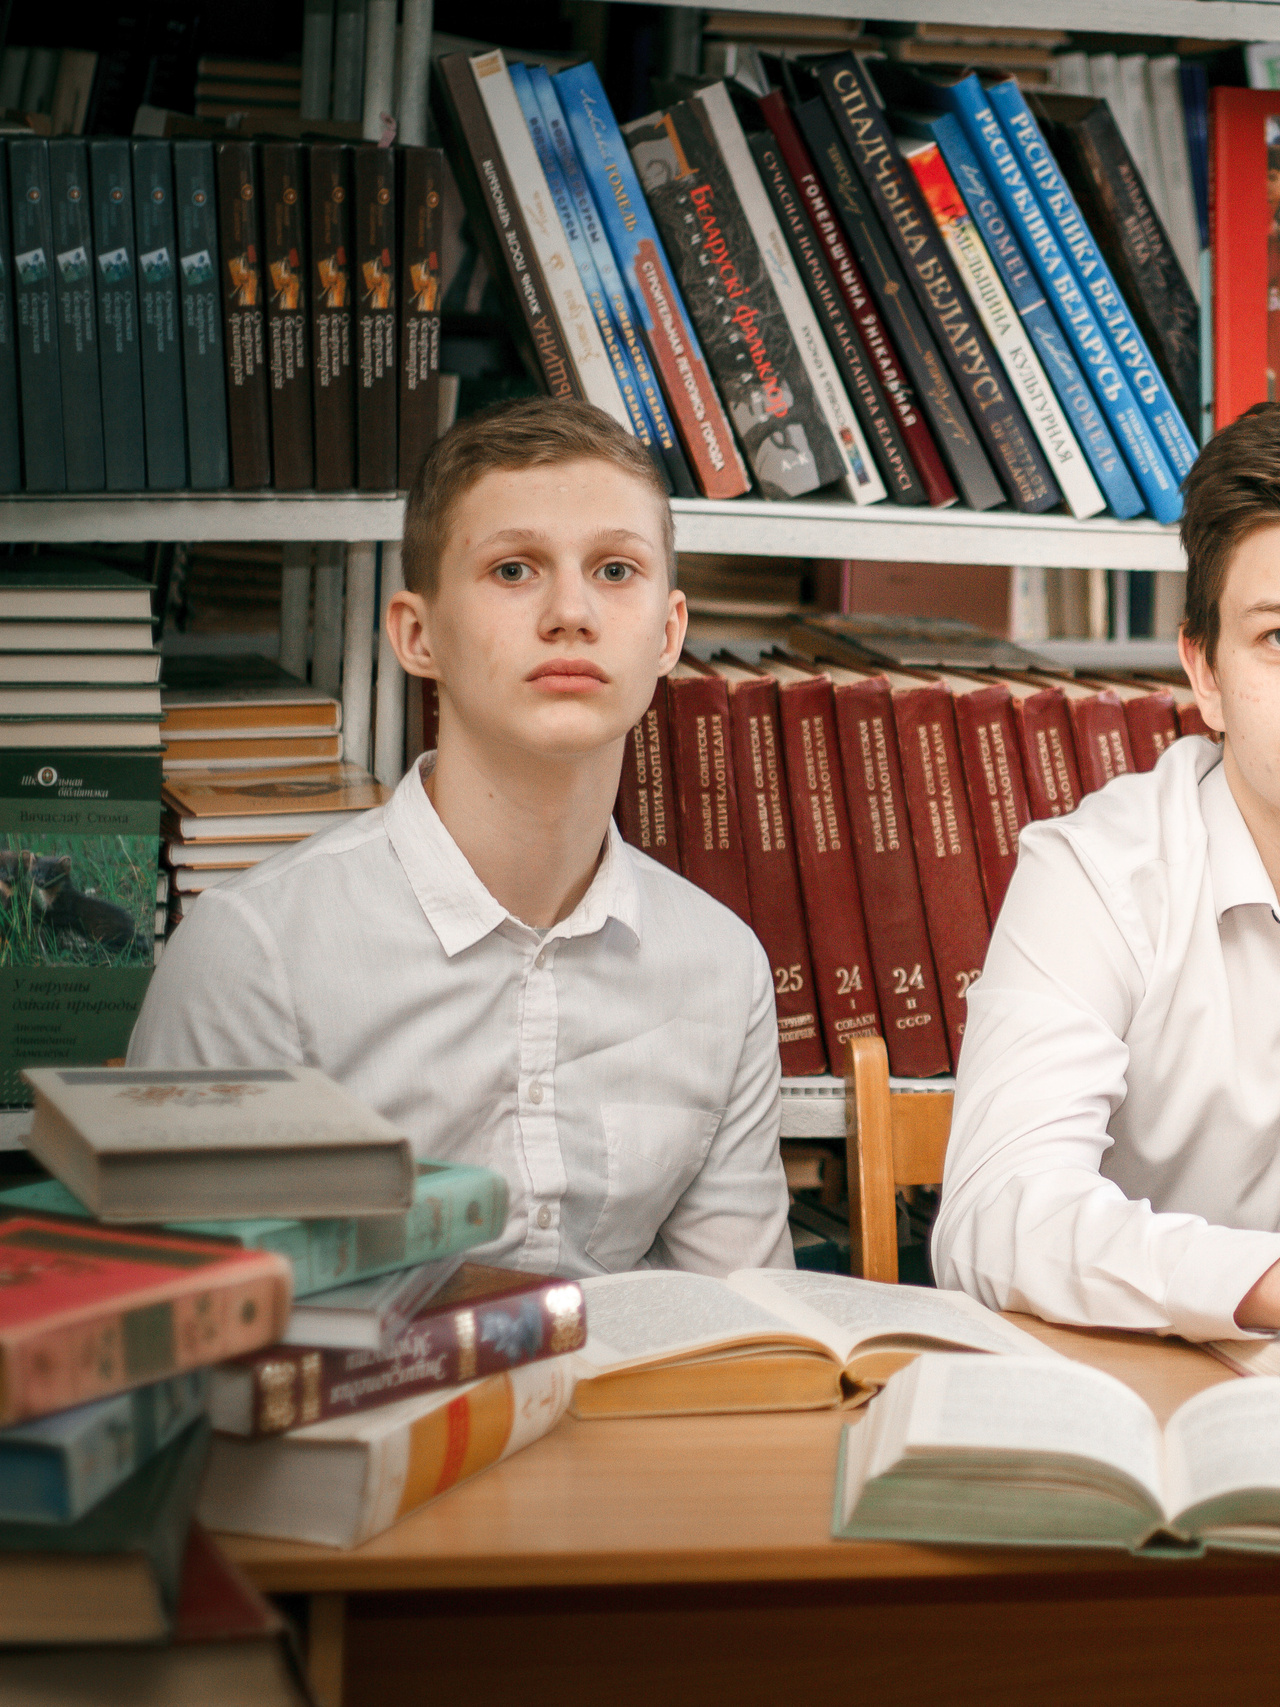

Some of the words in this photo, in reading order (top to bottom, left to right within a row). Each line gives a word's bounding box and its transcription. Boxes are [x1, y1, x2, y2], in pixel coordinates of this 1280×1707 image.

[482, 158, 512, 230] ЧЕРНОБЫЛЯ
[605, 163, 638, 232] ГОМЕЛЬ
[505, 229, 527, 272] ПОСЛЕ
[801, 173, 867, 310] ГОМЕЛЬШЧЫНА
[833, 69, 928, 257] СПАДЧЫНА
[915, 255, 1005, 413] БЕЛАРУСІ
[975, 107, 1062, 275] РЕСПУБЛИКА
[1053, 272, 1122, 402] БЕЛАРУСЬ
[977, 198, 1029, 288] GOMEL
[1010, 111, 1098, 278] РЕСПУБЛИКА
[1090, 277, 1160, 404] БЕЛАРУСЬ
[520, 272, 541, 316] ЖИЗНЬ
[763, 150, 804, 235] СУЧАСНАЕ
[797, 235, 840, 323] НАРОДНАЕ
[833, 317, 880, 416] МАСТАЦТВА
[873, 417, 912, 491] БЕЛАРУСІ
[590, 291, 628, 380] ГОМЕЛЬСКОЙ
[612, 293, 650, 383] ГОМЕЛЬСКОЙ
[645, 387, 673, 449] ОБЛАСТИ
[642, 261, 685, 356] СТРОИТЕЛЬНАЯ
[676, 356, 706, 421] ЛЕТОПИСЬ
[700, 420, 726, 472] ГОРОДА
[1009, 345, 1074, 464] КУЛЬТУРНАЯ
[1066, 382, 1118, 473] ГОМЕЛЬ
[646, 709, 667, 847] ЭНЦИКЛОПЕДИЯ
[696, 714, 710, 788] СОВЕТСКАЯ
[711, 714, 730, 850] ЭНЦИКЛОПЕДИЯ
[749, 717, 764, 789] СОВЕТСКАЯ
[762, 714, 786, 850] ЭНЦИКЛОПЕДИЯ
[801, 718, 817, 790] СОВЕТСКАЯ
[813, 716, 841, 850] ЭНЦИКЛОПЕДИЯ
[859, 719, 876, 791] СОВЕТСКАЯ
[872, 717, 900, 850] ЭНЦИКЛОПЕДИЯ
[918, 724, 936, 796] СОВЕТСКАЯ
[977, 725, 998, 796] СОВЕТСКАЯ
[1036, 731, 1057, 801] СОВЕТСКАЯ
[638, 788, 651, 848] БОЛЬШАЯ
[701, 792, 714, 851] БОЛЬШАЯ
[756, 793, 771, 852] БОЛЬШАЯ
[810, 794, 827, 853] БОЛЬШАЯ
[868, 794, 884, 853] БОЛЬШАЯ
[931, 722, 962, 855] ЭНЦИКЛОПЕДИЯ
[929, 800, 946, 858] БОЛЬШАЯ
[990, 799, 1009, 857] БОЛЬШАЯ
[774, 964, 804, 994] 25
[835, 965, 863, 995] 24
[892, 963, 926, 994] 24
[834, 1013, 876, 1032] СОБАКИ
[895, 1013, 932, 1030] СССР
